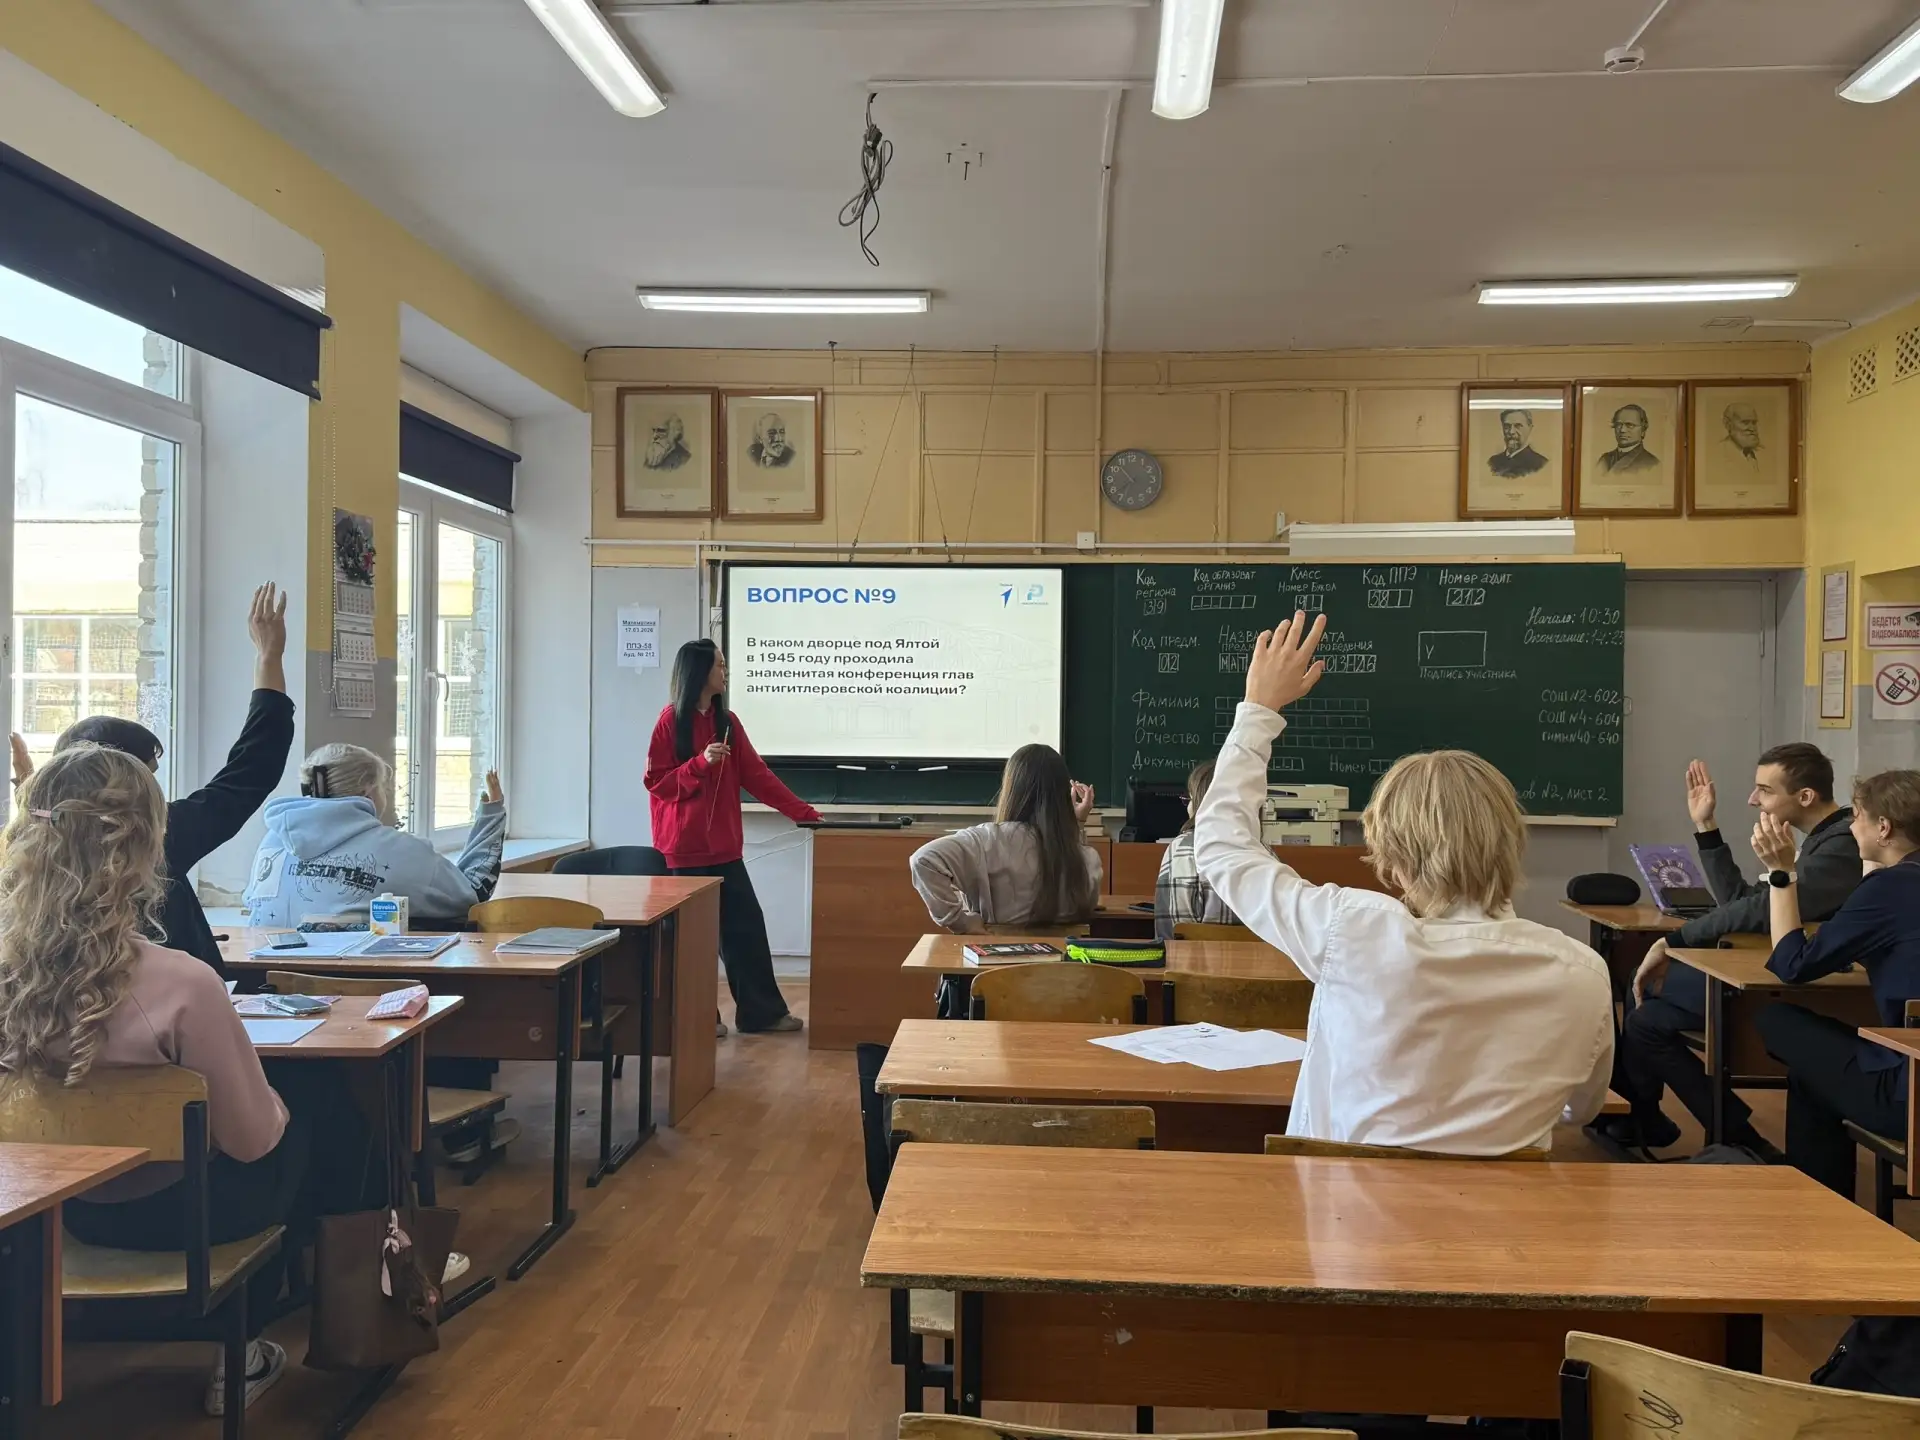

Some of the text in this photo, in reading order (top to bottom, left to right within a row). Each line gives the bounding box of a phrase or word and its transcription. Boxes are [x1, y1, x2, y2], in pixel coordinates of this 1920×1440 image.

[1136, 568, 1156, 586] Код
[1194, 568, 1209, 582] Код
[1363, 566, 1417, 587] Код ППЭ
[1439, 569, 1478, 585] Номер
[748, 587, 897, 604] ВОПРОС №9
[1136, 588, 1176, 600] региона
[1526, 606, 1621, 627] Начало: 10:30
[1872, 616, 1901, 628] ВЕДЕТСЯ
[626, 642, 652, 650] ППЭ-58
[747, 637, 940, 651] В каком дворце под Ялтой
[1132, 629, 1156, 650] Код
[747, 653, 914, 666] в 1945 году проходила
[746, 668, 975, 681] знаменитая конференция глав
[746, 683, 967, 697] антигитлеровской коалиции?
[1541, 689, 1567, 702] СОШ
[1136, 711, 1167, 727] Имя
[1538, 709, 1566, 724] СОШ
[1135, 726, 1200, 745] Отчество
[1132, 750, 1197, 771] Документ
[1330, 753, 1365, 773] Номер
[1598, 786, 1610, 802] 2
